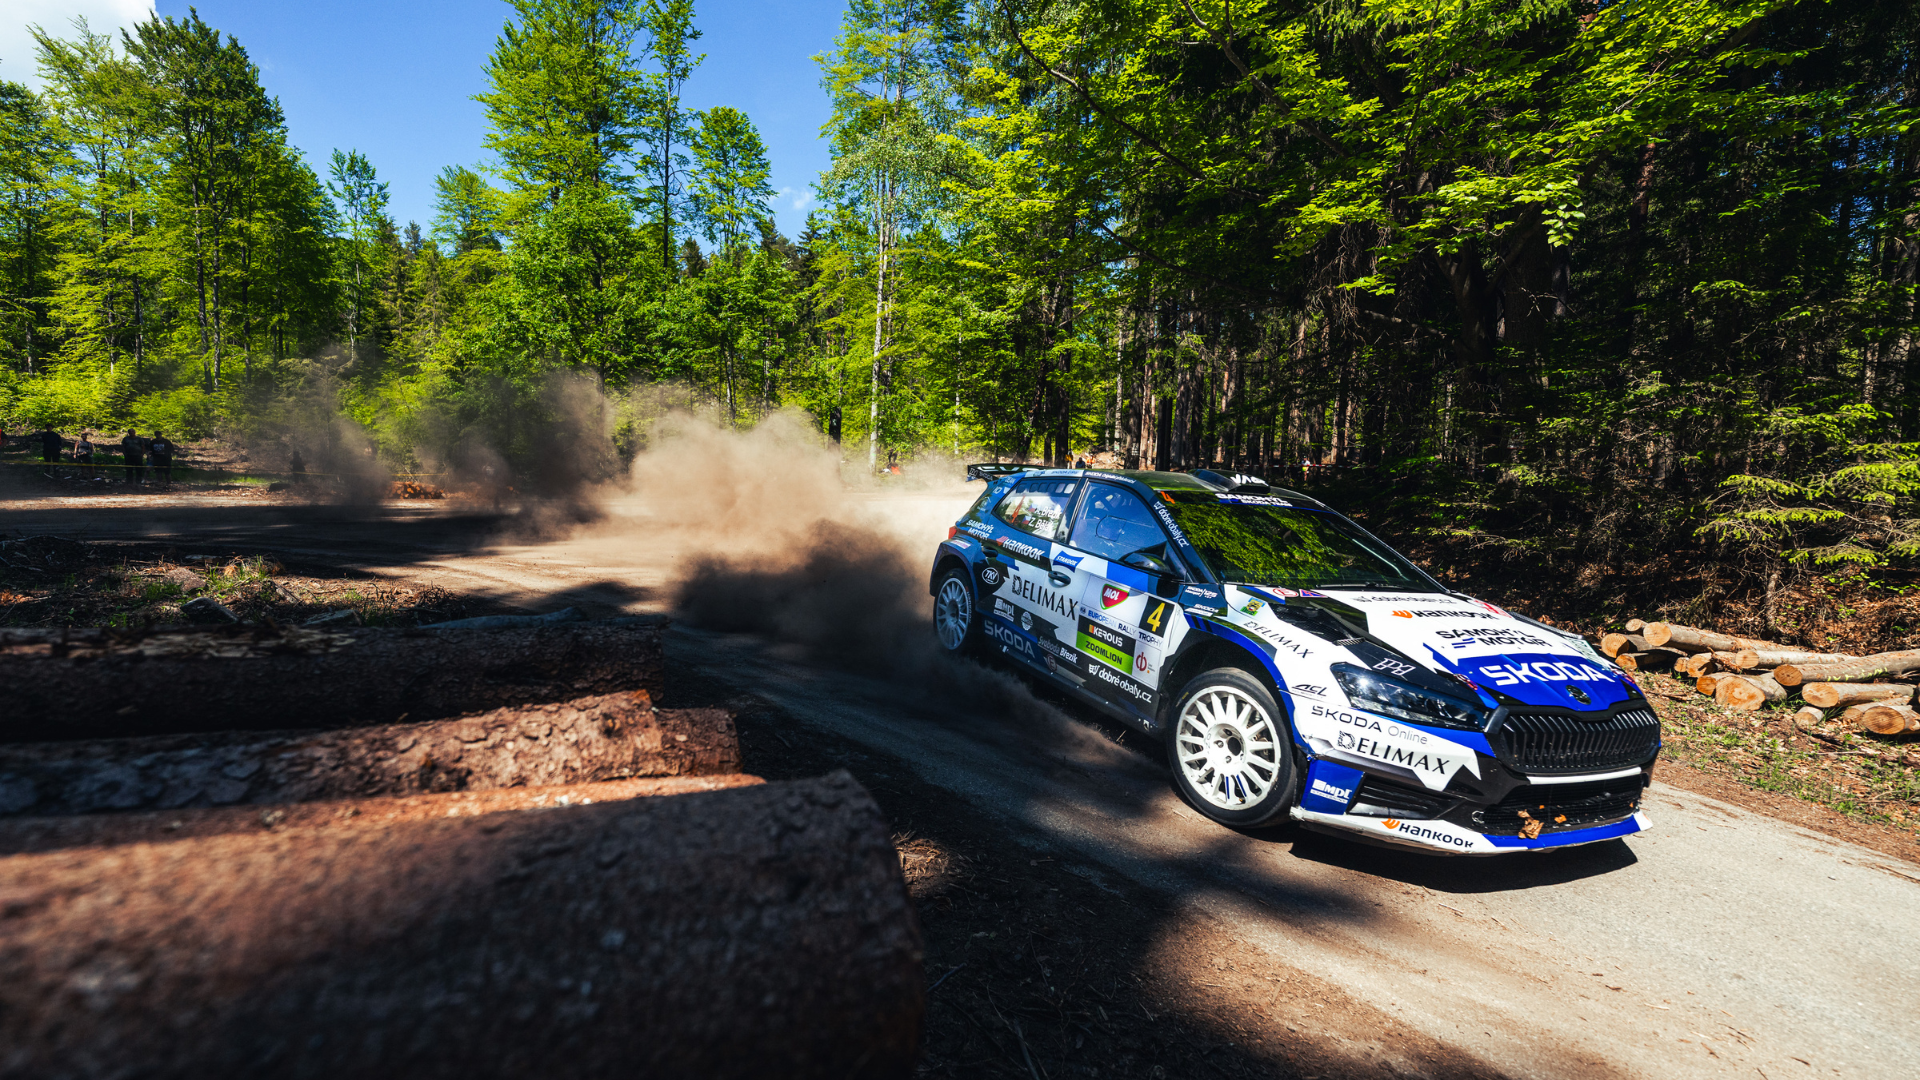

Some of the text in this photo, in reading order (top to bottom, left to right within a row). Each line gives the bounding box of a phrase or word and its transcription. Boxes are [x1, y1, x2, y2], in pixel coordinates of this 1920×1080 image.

[967, 527, 990, 541] MOTOR
[1011, 574, 1079, 621] DELIMAX
[1103, 587, 1120, 601] MOL
[1146, 602, 1166, 632] 4
[1242, 620, 1314, 659] DELIMAX
[1477, 637, 1553, 648] MOTOR
[1085, 640, 1123, 665] ZOOMLION
[1387, 725, 1429, 745] Online
[1337, 730, 1450, 775] DELIMAX
